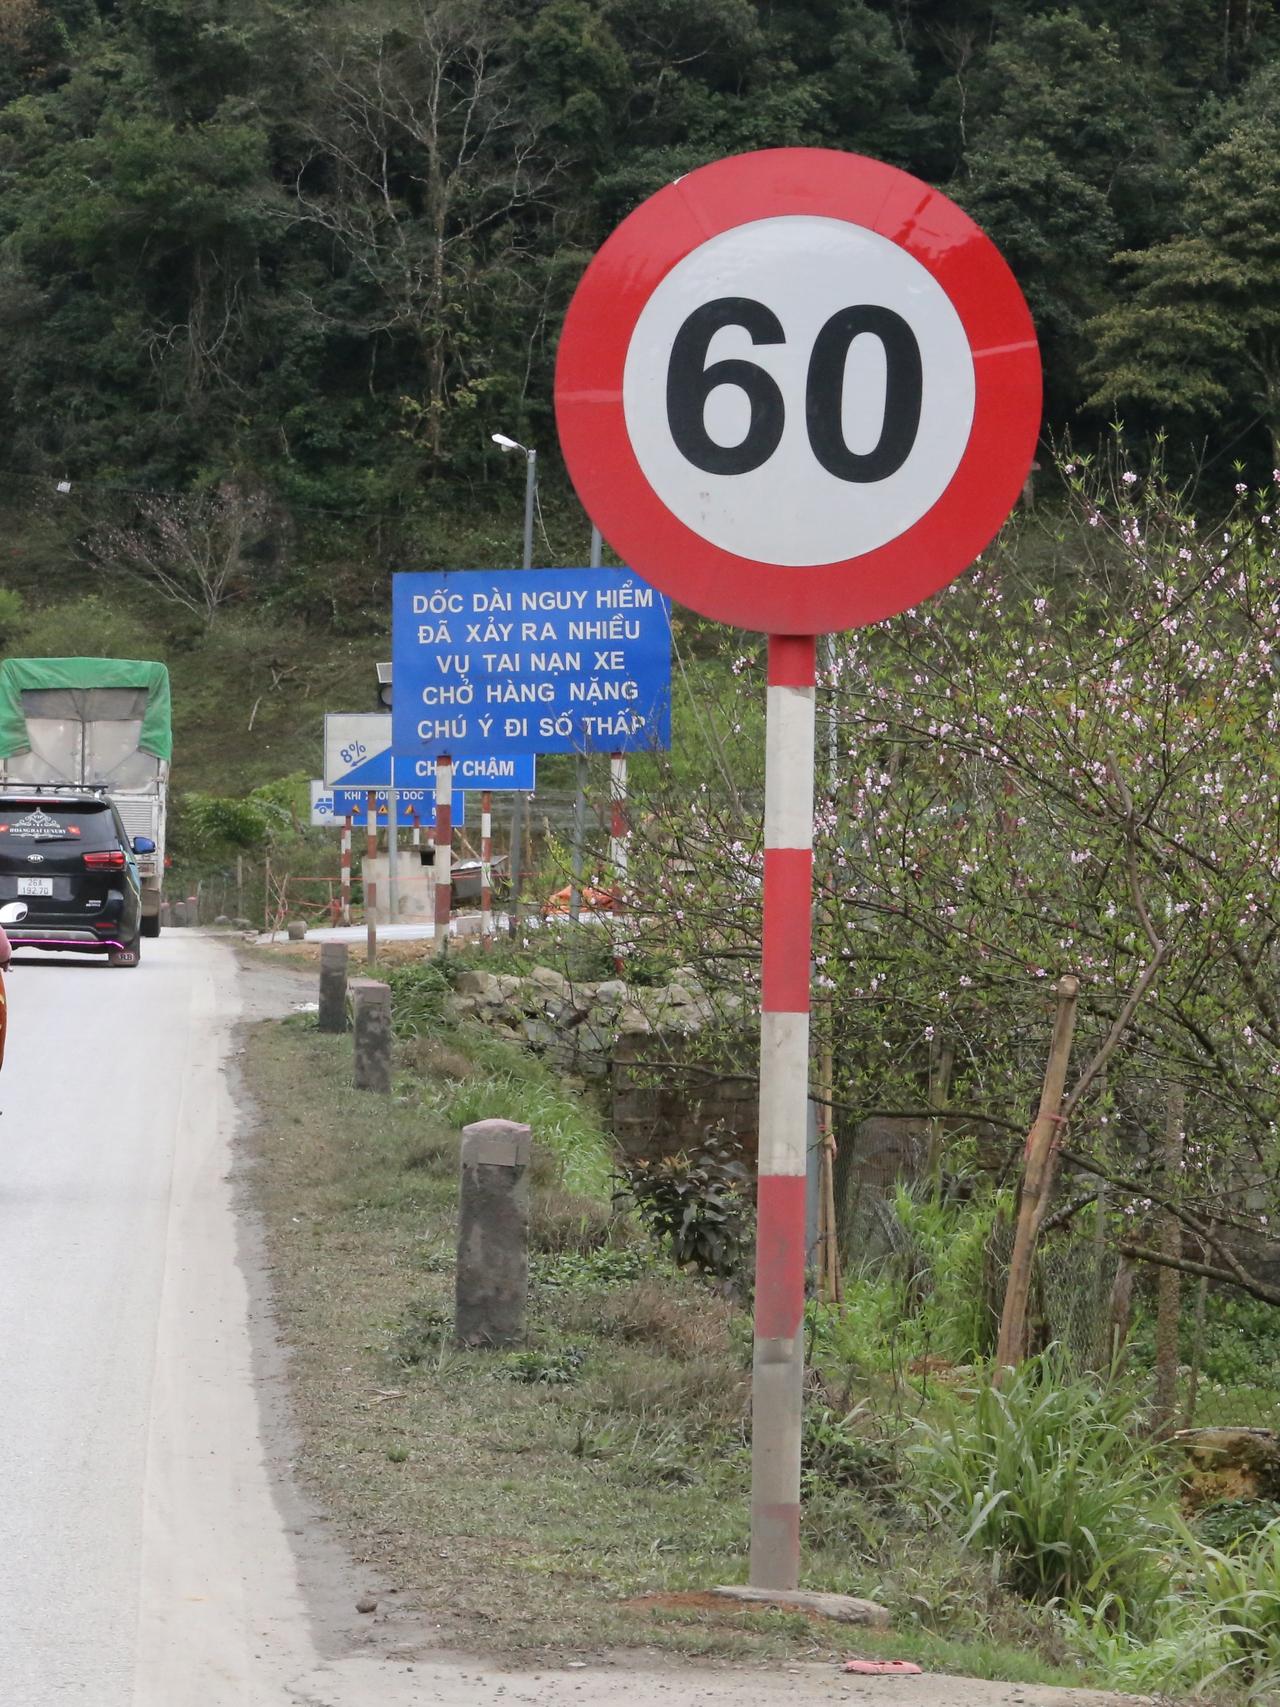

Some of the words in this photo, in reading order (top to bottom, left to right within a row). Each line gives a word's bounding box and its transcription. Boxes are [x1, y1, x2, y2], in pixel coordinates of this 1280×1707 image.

[666, 297, 922, 482] 60
[413, 589, 463, 614] DỐC
[473, 587, 511, 613] DÀI
[522, 590, 588, 610] NGUY
[596, 580, 653, 608] HIỂM
[418, 620, 451, 644] ĐÃ
[466, 616, 513, 642] XẢY
[522, 623, 557, 641] RA
[569, 613, 640, 640] NHIỀU
[436, 655, 469, 678] VỤ
[483, 653, 519, 672] TAI
[530, 652, 580, 676] NẠN
[593, 651, 625, 670] XE
[422, 678, 473, 705] CHỞ
[487, 679, 555, 703] HÀNG
[570, 677, 639, 706] NẶNG
[417, 714, 467, 739] CHÚ
[478, 713, 494, 737] Ý
[505, 718, 527, 737] ĐI
[539, 710, 573, 736] SỐ
[582, 708, 646, 736] THẤP
[340, 740, 366, 763] 8%
[415, 760, 460, 777] CHY
[462, 756, 514, 780] CHẬM
[344, 791, 361, 800] KHI
[28, 878, 42, 887] 26A
